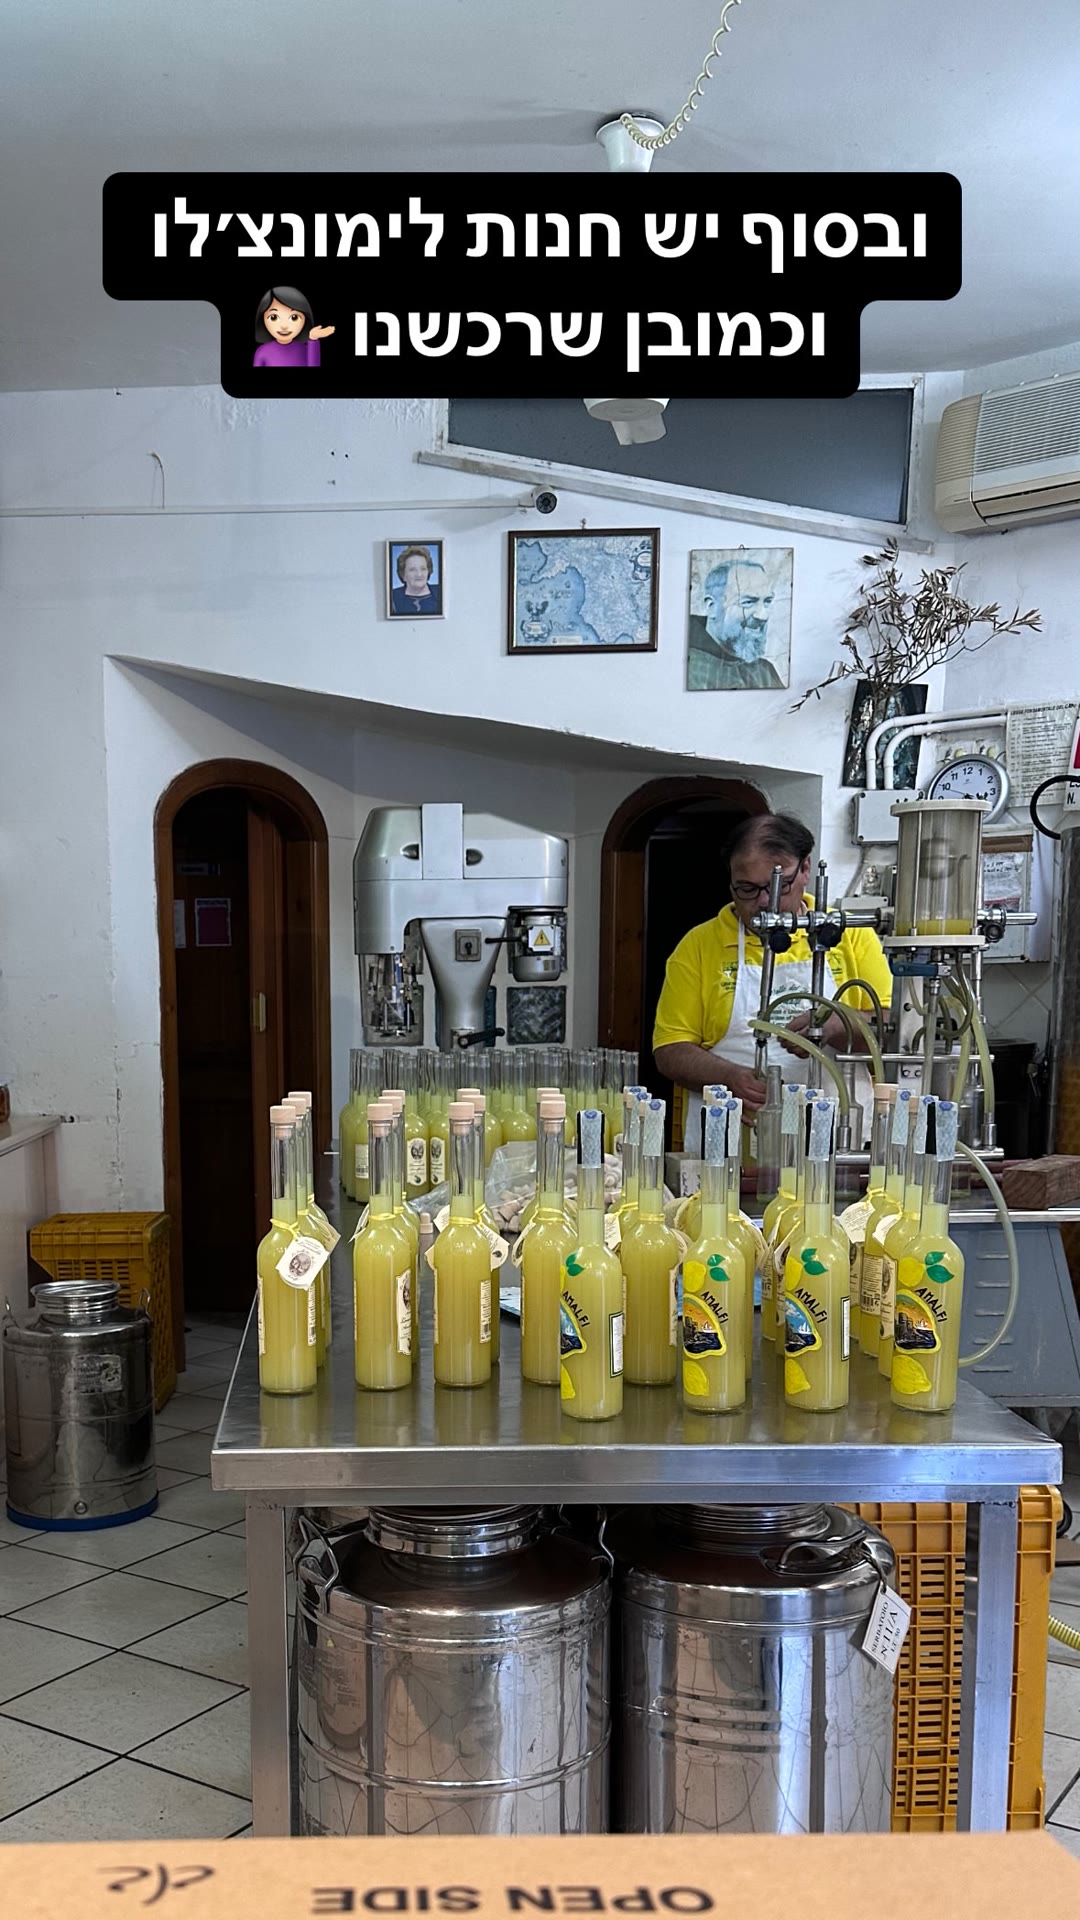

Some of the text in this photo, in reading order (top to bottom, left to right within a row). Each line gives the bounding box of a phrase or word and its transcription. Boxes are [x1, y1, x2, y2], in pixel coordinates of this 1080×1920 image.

[951, 772, 959, 781] 11
[962, 766, 974, 775] 12
[978, 767, 983, 776] 1
[987, 775, 994, 784] 2
[941, 782, 951, 791] 10
[989, 787, 996, 796] 3
[562, 1290, 591, 1328] AMALFI
[700, 1290, 729, 1325] AMALFI
[794, 1287, 828, 1324] AMALFI
[913, 1287, 948, 1323] AMALFI
[871, 1601, 889, 1654] SERBATOIO
[315, 1886, 714, 1913] OPEN SIDE
